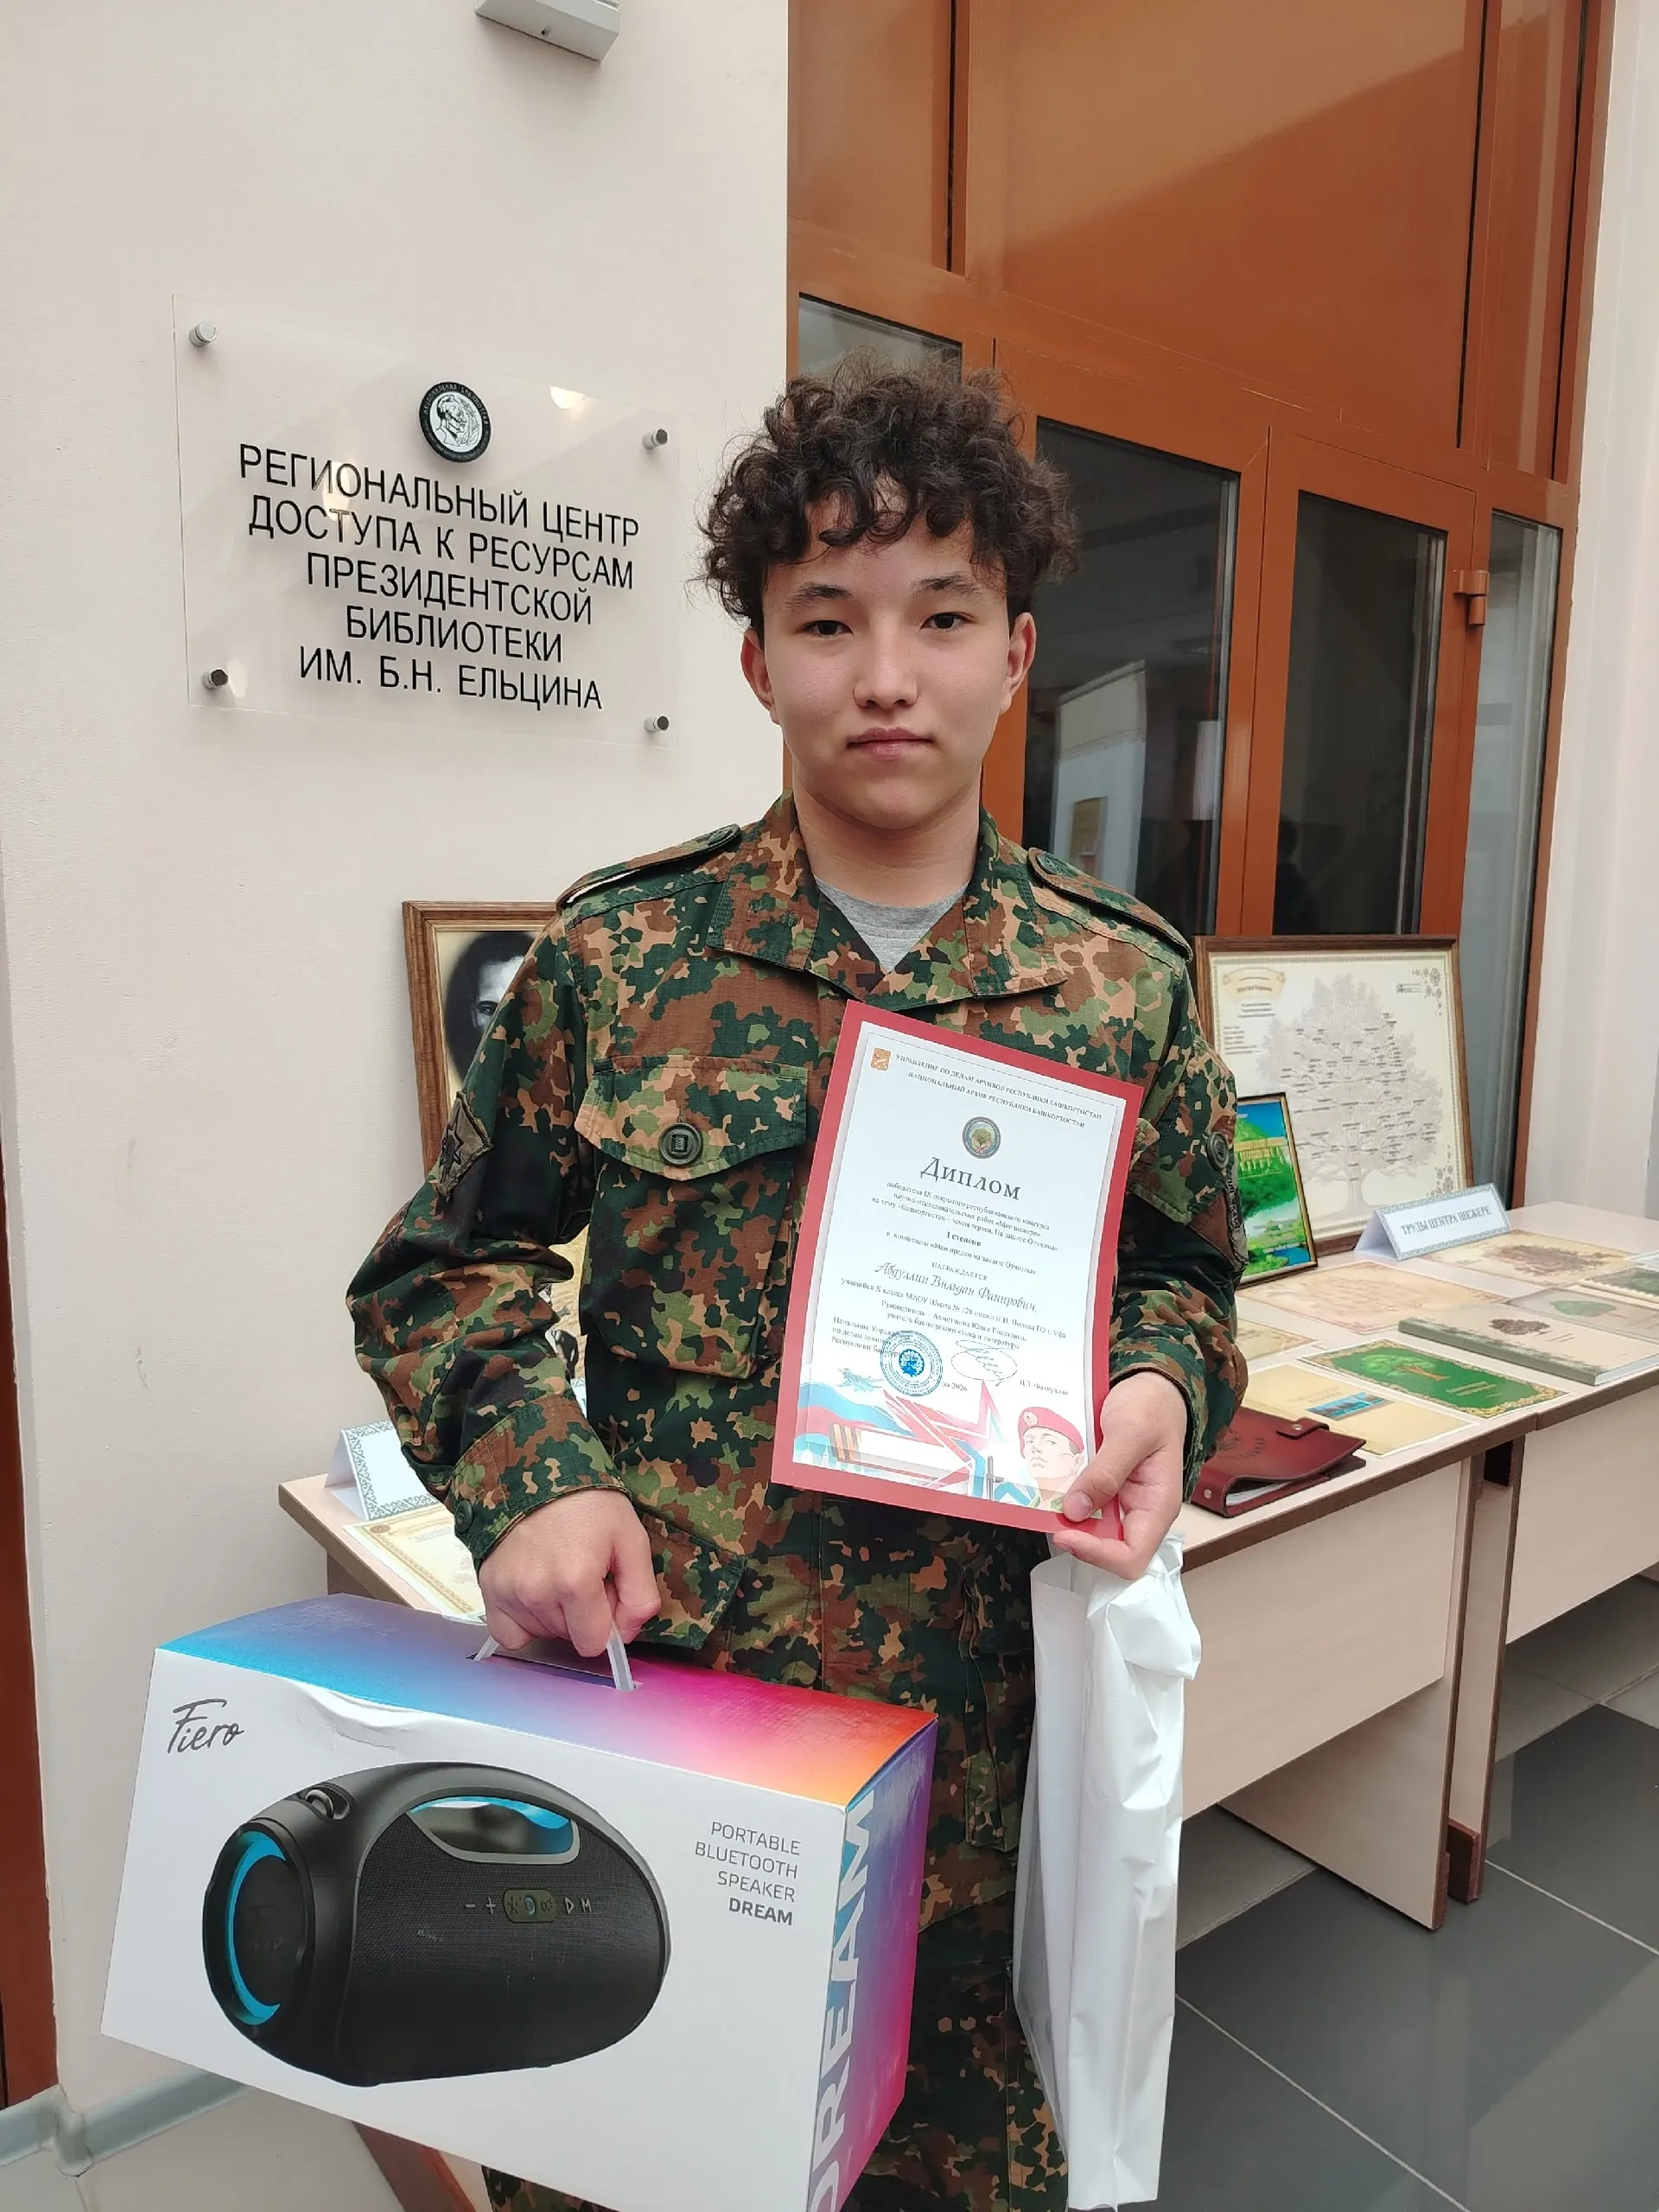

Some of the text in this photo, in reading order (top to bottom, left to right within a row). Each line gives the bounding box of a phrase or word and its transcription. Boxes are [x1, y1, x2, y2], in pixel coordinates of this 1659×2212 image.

[240, 443, 639, 547] РЕГИОНАЛЬНЫЙ ЦЕНТР
[249, 494, 632, 590] ДОСТУПА К РЕСУРСАМ
[308, 552, 592, 625] ПРЕЗИДЕНТСКОЙ
[346, 605, 562, 663] БИБЛИОТЕКИ
[301, 645, 602, 711] ИМ. Б.Н. ЕЛЬЦИНА
[896, 1054, 938, 1071] УПРАВЛЕНИЕ
[950, 1071, 975, 1083] ДЕЛАМ
[976, 1078, 1005, 1091] АРХИВОВ
[1006, 1087, 1049, 1104] РЕСПУБЛИКИ
[1049, 1100, 1102, 1120] БАШКОРТОСТАН
[908, 1071, 1085, 1128] НАЦИОНАЛЬНЫЙ АРХИВ РЕСПУБЛИКИ БАШКОРТОСТАН
[951, 1234, 982, 1247] степени
[1400, 1205, 1492, 1236] ТРУДЫ ЦЕНТРА ШЕЖЕРЕ
[931, 1262, 988, 1281] НАГРАЖДАЕТСЯ
[167, 1698, 245, 1754] Fiero
[694, 1841, 798, 1879] BLUETOOTH
[710, 1821, 802, 1856] PORTABLE
[717, 1870, 796, 1903] SPEAKER
[728, 1897, 793, 1926] DREAM
[807, 1789, 875, 2212] DREAM
